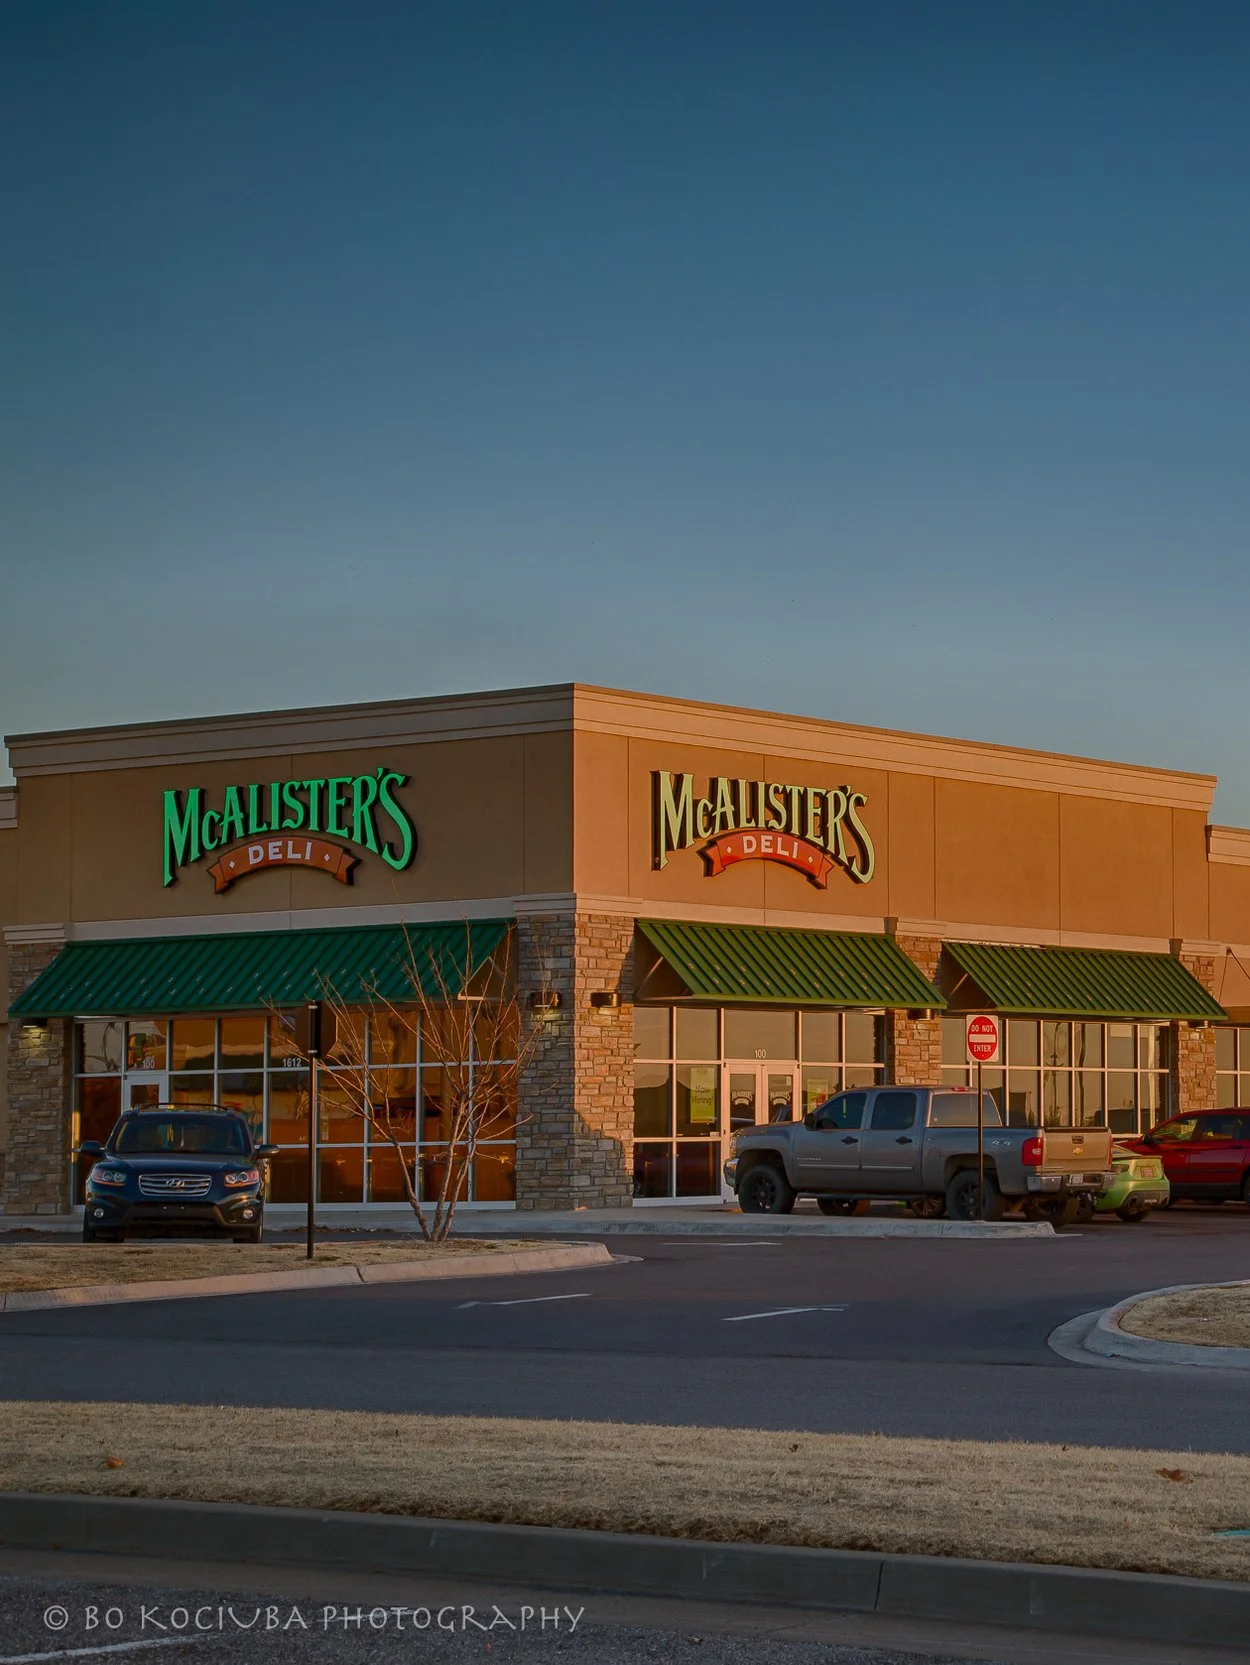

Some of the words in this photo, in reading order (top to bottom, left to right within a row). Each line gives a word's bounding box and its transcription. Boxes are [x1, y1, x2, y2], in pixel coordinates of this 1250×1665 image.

[163, 767, 417, 888] McALISTER'S
[650, 770, 875, 884] McALISTER'S
[248, 841, 312, 865] DELI
[743, 835, 798, 859] DELI
[142, 1059, 155, 1069] 100
[282, 1057, 303, 1068] 1612
[754, 1049, 766, 1058] 100
